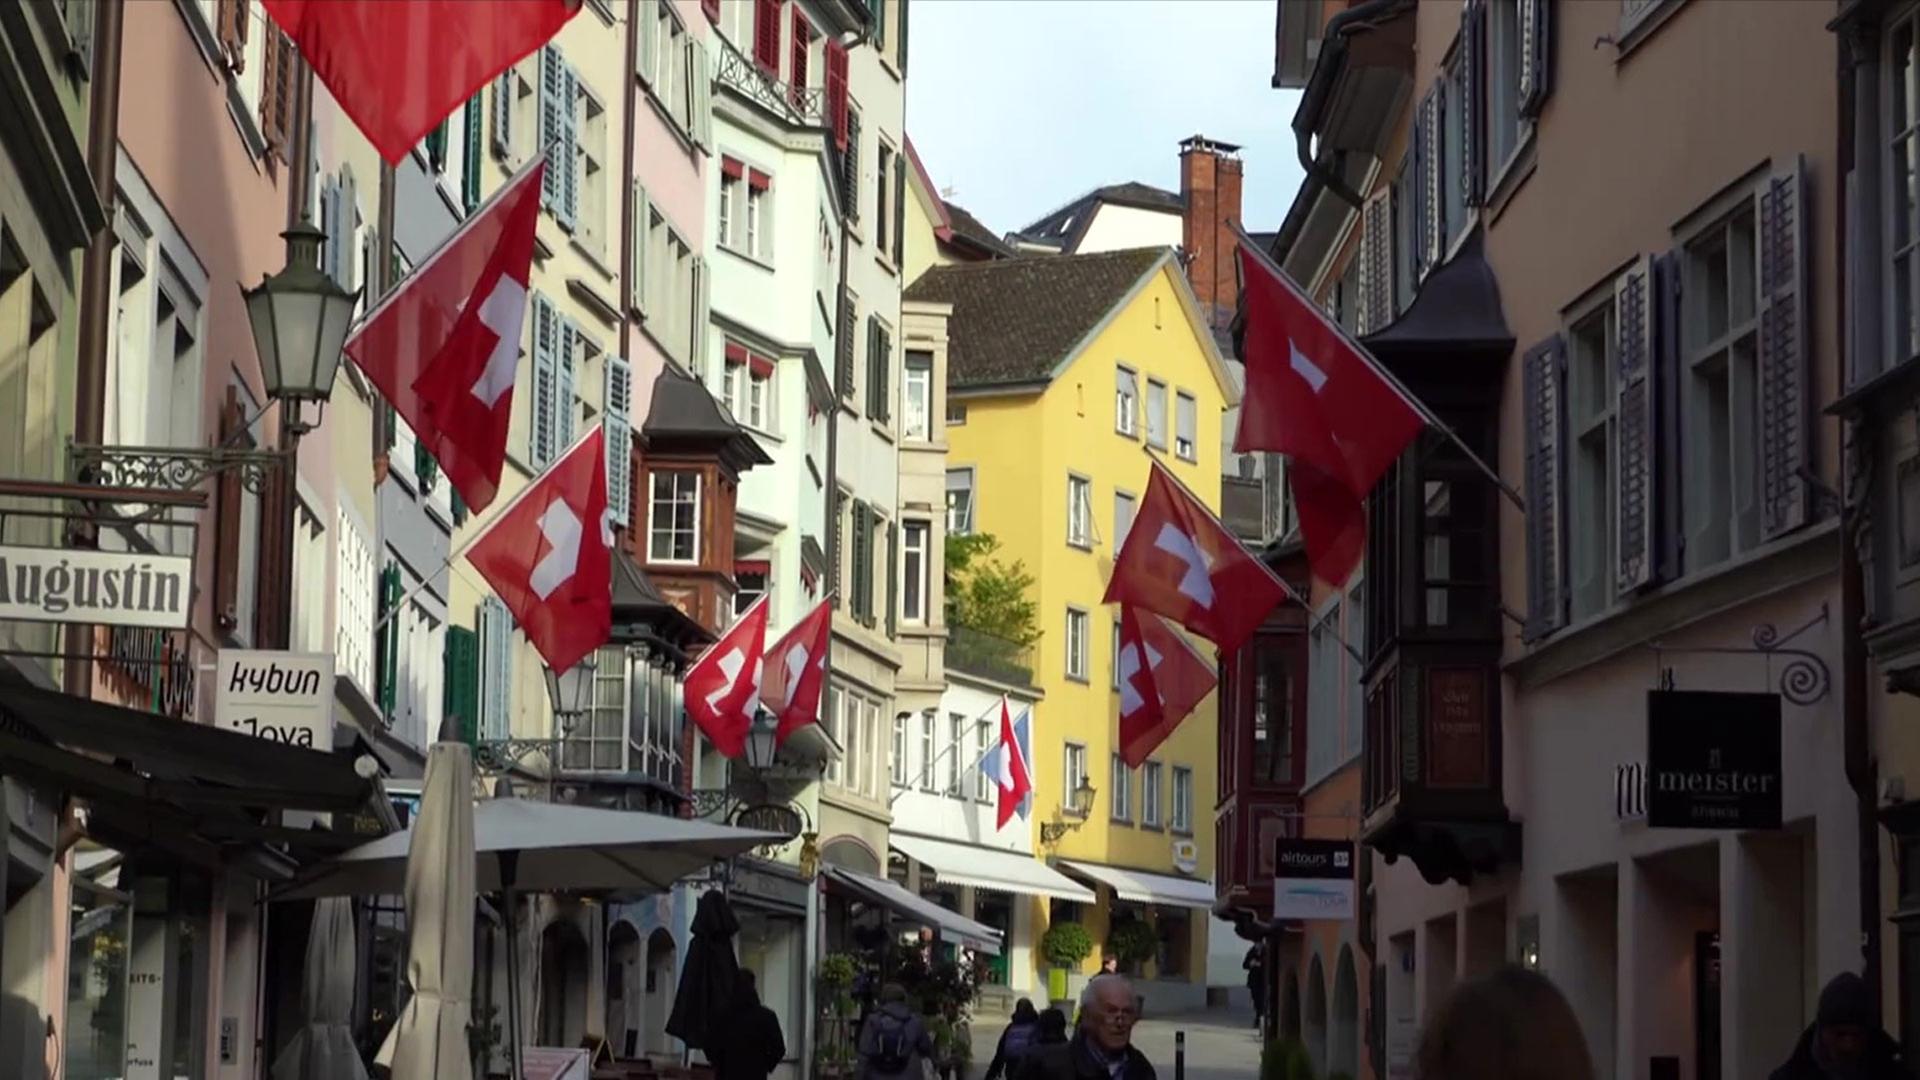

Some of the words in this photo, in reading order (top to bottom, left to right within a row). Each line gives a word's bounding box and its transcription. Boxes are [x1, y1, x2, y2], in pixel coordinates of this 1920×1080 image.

[229, 661, 321, 696] kybun
[1657, 769, 1775, 794] meister
[1280, 850, 1328, 865] airtours
